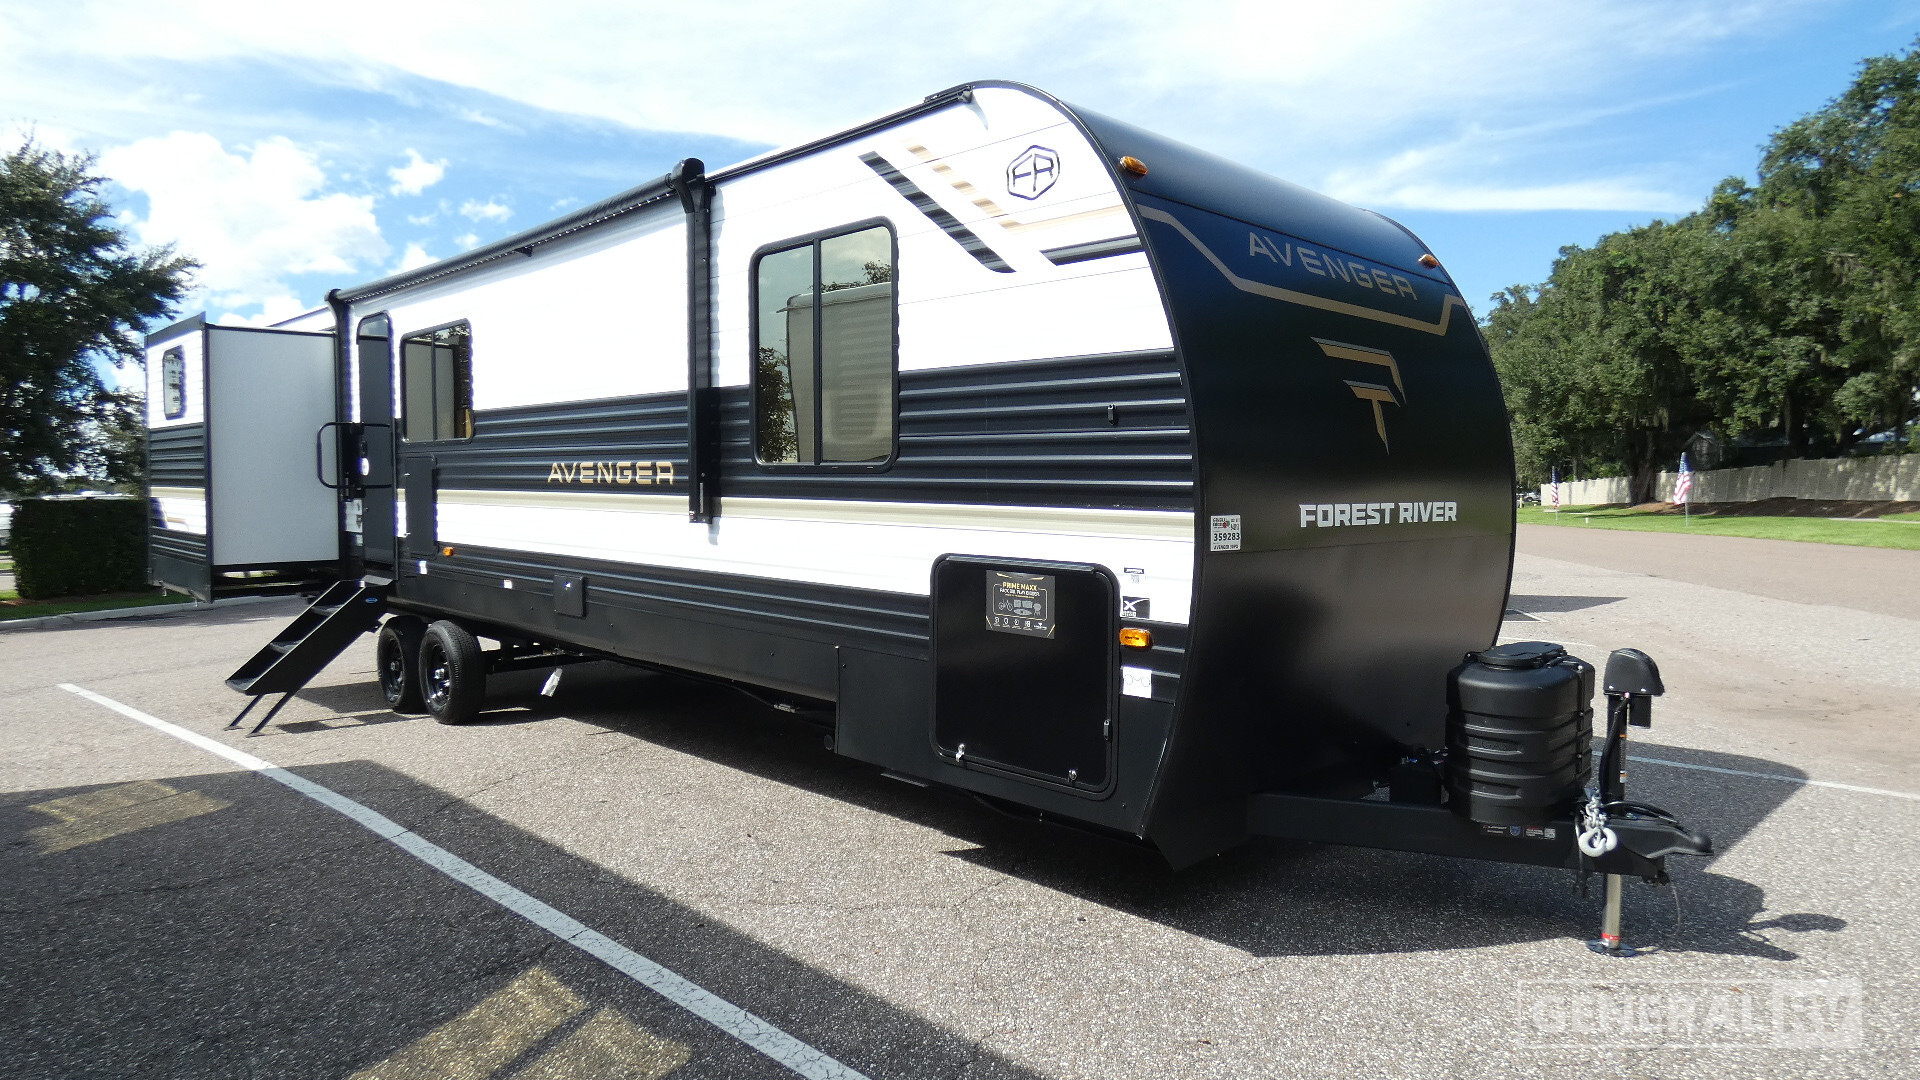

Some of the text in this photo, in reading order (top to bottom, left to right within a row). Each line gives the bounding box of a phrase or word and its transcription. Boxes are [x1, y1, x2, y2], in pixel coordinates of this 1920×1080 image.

[1249, 231, 1418, 300] AVENGER
[547, 461, 674, 485] AVENGER
[1299, 501, 1457, 528] FOREST RIVER
[1213, 532, 1240, 542] 359283
